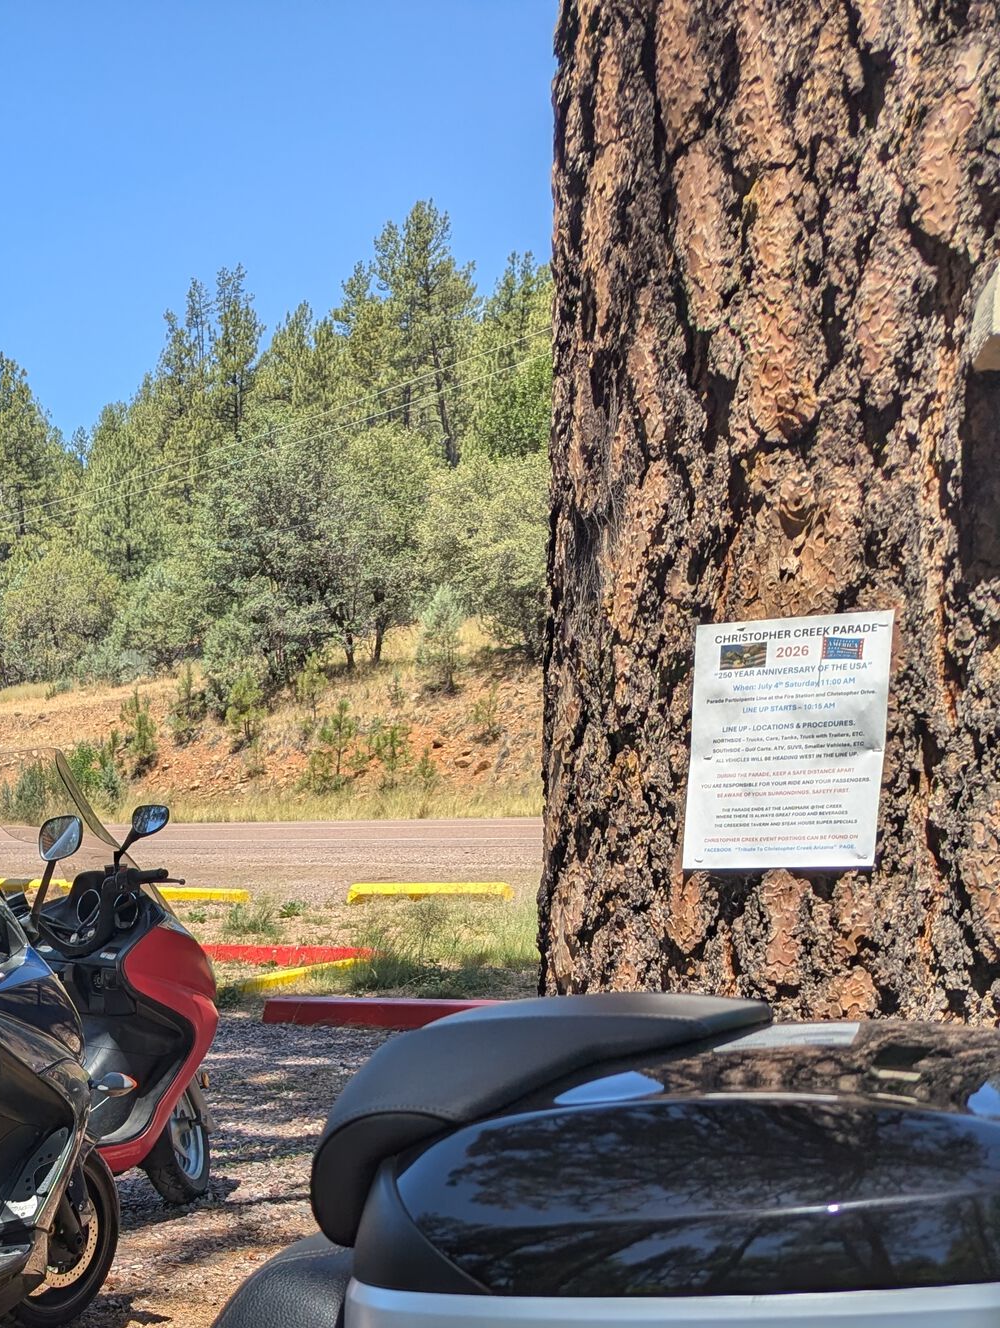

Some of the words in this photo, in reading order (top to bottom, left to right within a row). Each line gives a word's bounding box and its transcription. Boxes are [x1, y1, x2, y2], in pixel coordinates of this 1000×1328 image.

[715, 630, 791, 644] CHRISTOPHER
[794, 627, 830, 639] CREEK
[832, 623, 878, 636] PARADE
[776, 646, 809, 658] 2026
[735, 670, 754, 678] YEAR
[757, 666, 815, 676] ANNIVERSARY
[831, 663, 847, 671] THE
[733, 683, 756, 691] When:
[758, 682, 772, 690] July
[753, 723, 794, 731] LOCATIONS
